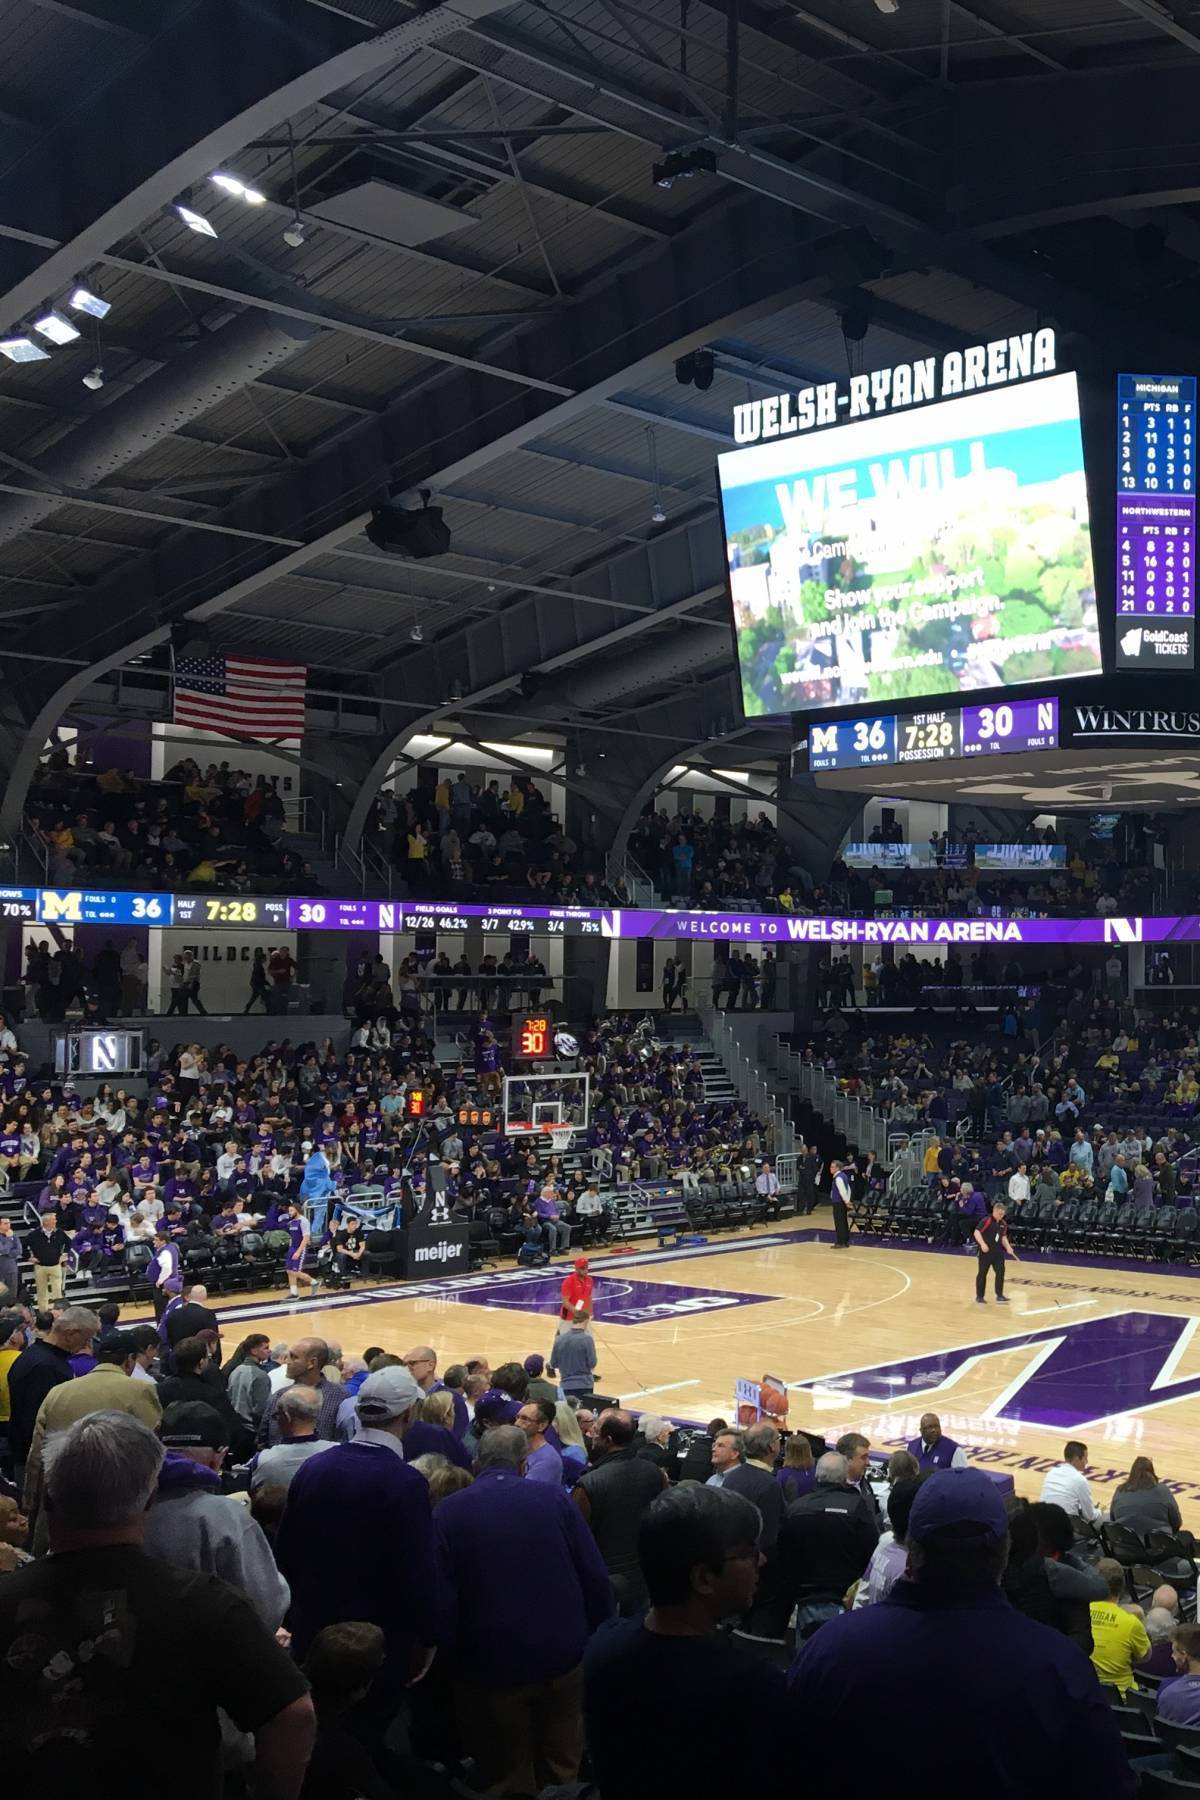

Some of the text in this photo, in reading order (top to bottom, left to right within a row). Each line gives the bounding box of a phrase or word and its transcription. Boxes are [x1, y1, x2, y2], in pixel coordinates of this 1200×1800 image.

[733, 327, 1056, 444] WELSH-RYAN ARENA
[1136, 384, 1179, 393] MICHIGAN
[1144, 402, 1160, 412] PTS
[1166, 404, 1179, 412] RB
[1184, 404, 1192, 413] F
[1122, 416, 1190, 430] 1 3 1 1
[1122, 431, 1191, 445] 2 11 1 0
[1122, 446, 1190, 460] 3 8 3 1
[1122, 462, 1191, 475] 4 0 3 0
[1122, 477, 1191, 490] 13 10 1 0
[1122, 506, 1191, 517] NORTHWESTERN
[1143, 526, 1159, 535] PTS
[1165, 527, 1178, 536] RB
[1184, 528, 1190, 536] F
[1122, 540, 1190, 553] 4 8 2 3
[1122, 555, 1190, 568] 5 16 4 0
[1122, 570, 1189, 583] 11 0 3 1
[1122, 585, 1190, 598] 14 4 0 2
[1122, 600, 1190, 612] 21 0 2 0
[1143, 629, 1188, 643] GoldCoast
[1155, 643, 1188, 655] TICKETS
[913, 712, 946, 726] 1ST HALF
[977, 705, 1013, 739] 30
[1037, 702, 1053, 731] N
[812, 725, 838, 753] M
[853, 720, 886, 751] 36
[905, 722, 953, 749] 7:28
[899, 747, 944, 762] POSSESSION
[42, 891, 82, 920] M
[85, 895, 106, 904] FOULS
[178, 900, 196, 909] HALF
[3, 903, 32, 917] 70%
[132, 898, 162, 919] 36
[206, 901, 257, 921] 7:28
[265, 903, 285, 912] POSS.
[298, 904, 326, 923] 30
[416, 905, 458, 914] FIELD GOALS
[492, 908, 512, 916] POINT
[180, 910, 192, 919] 1ST
[379, 904, 394, 928] N
[405, 916, 434, 928] 12/26
[439, 917, 468, 929] 46.2%
[481, 918, 498, 931] 3/7
[508, 920, 534, 931] 42.9%
[547, 920, 564, 932] 3/4
[581, 922, 600, 932] 75%
[676, 919, 1022, 942] WELCOME TO WELSH-RYAN ARENA
[1105, 917, 1143, 943] N
[525, 1019, 547, 1032] 7:28
[522, 1032, 543, 1053] 30
[92, 1036, 116, 1070] N
[435, 1191, 445, 1207] N
[414, 1240, 463, 1262] meijer
